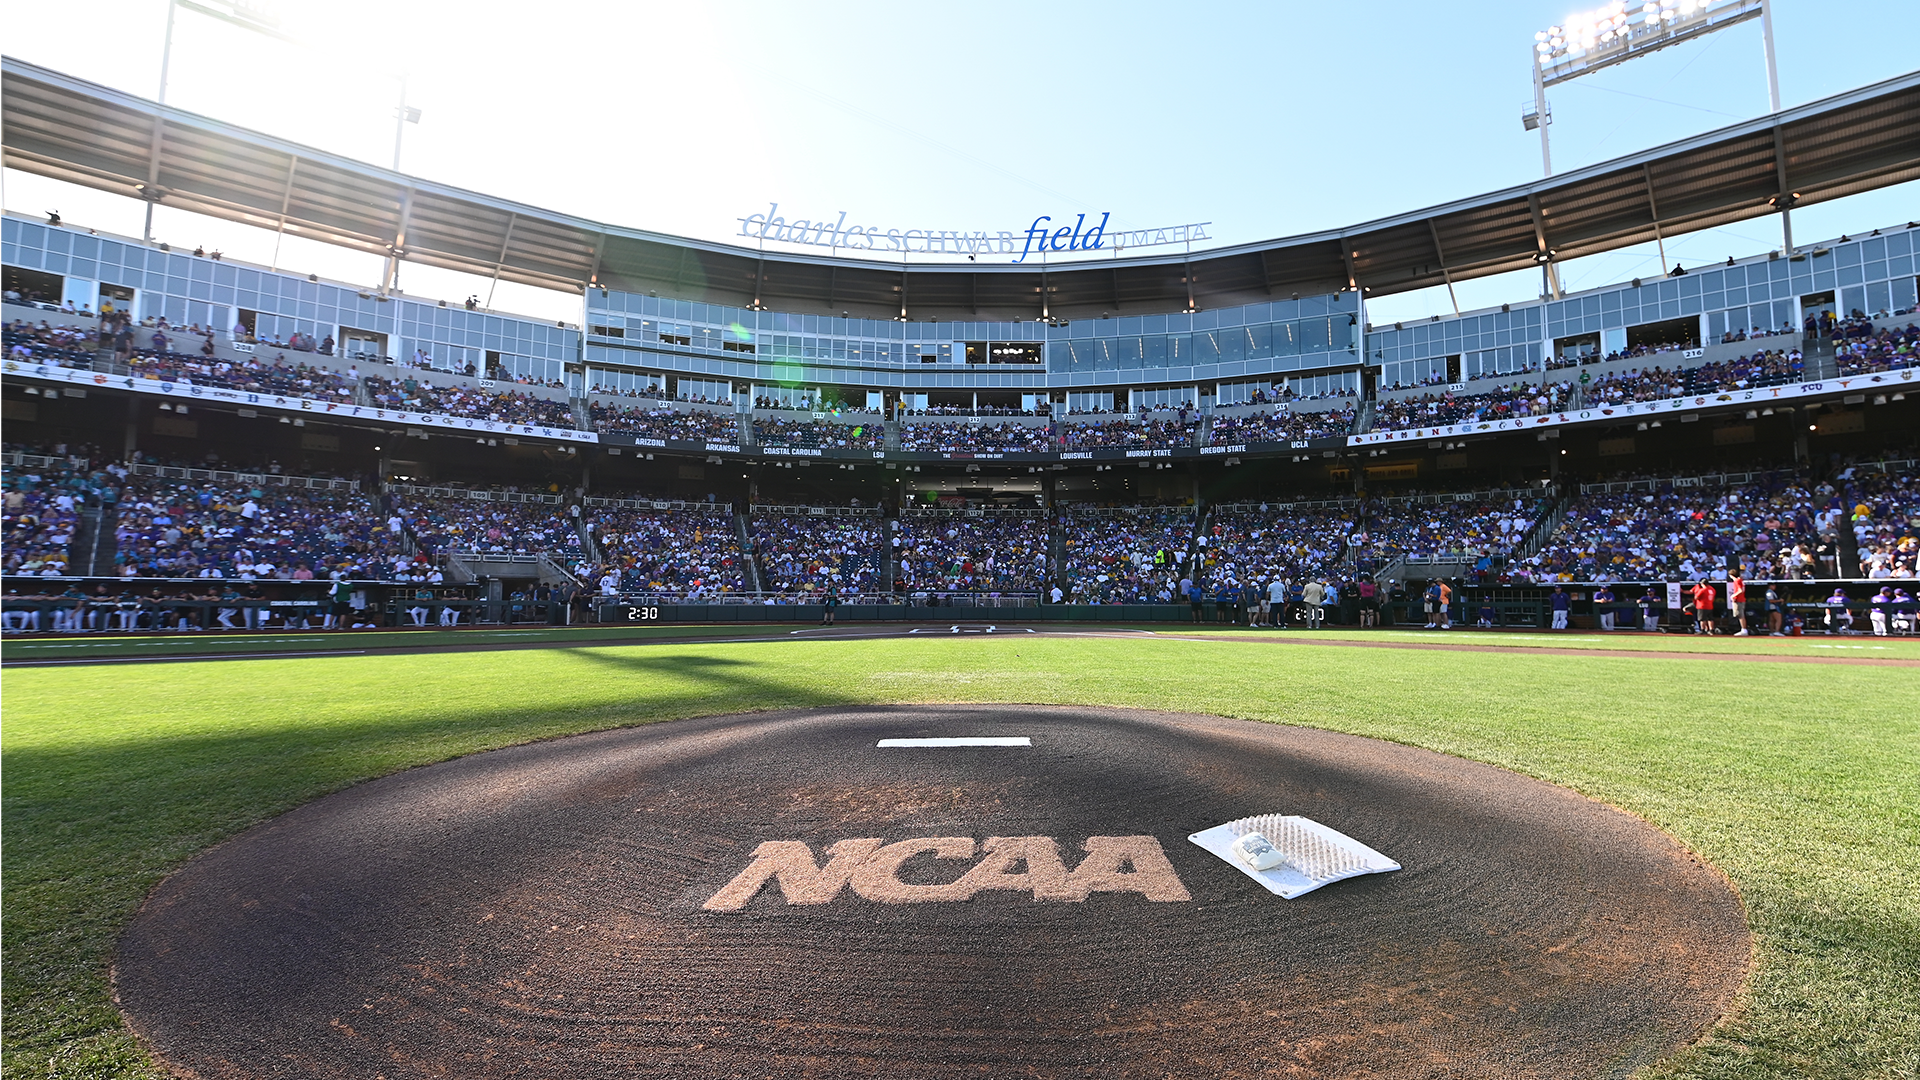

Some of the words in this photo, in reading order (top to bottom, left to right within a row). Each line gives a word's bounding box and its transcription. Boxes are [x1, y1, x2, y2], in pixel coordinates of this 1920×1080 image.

[742, 202, 878, 250] charles
[886, 227, 1014, 255] SCHWAB
[1011, 211, 1110, 263] field
[1113, 222, 1208, 248] OMAHA
[1685, 349, 1702, 357] 216
[1801, 383, 1822, 392] TCU
[635, 438, 665, 447] ARIZONA
[1291, 441, 1309, 449] UCLA
[705, 443, 740, 453] ARKANSAS
[763, 447, 790, 455] COASTAL
[791, 448, 822, 456] CAROLINA
[1200, 446, 1226, 455] OREGON
[1227, 444, 1246, 453] STATE
[1060, 452, 1093, 460] LOUISVILLE
[1126, 450, 1152, 458] MURRAY
[1153, 449, 1172, 457] STATE
[628, 607, 658, 620] 2:30
[702, 834, 1193, 912] NCAA
